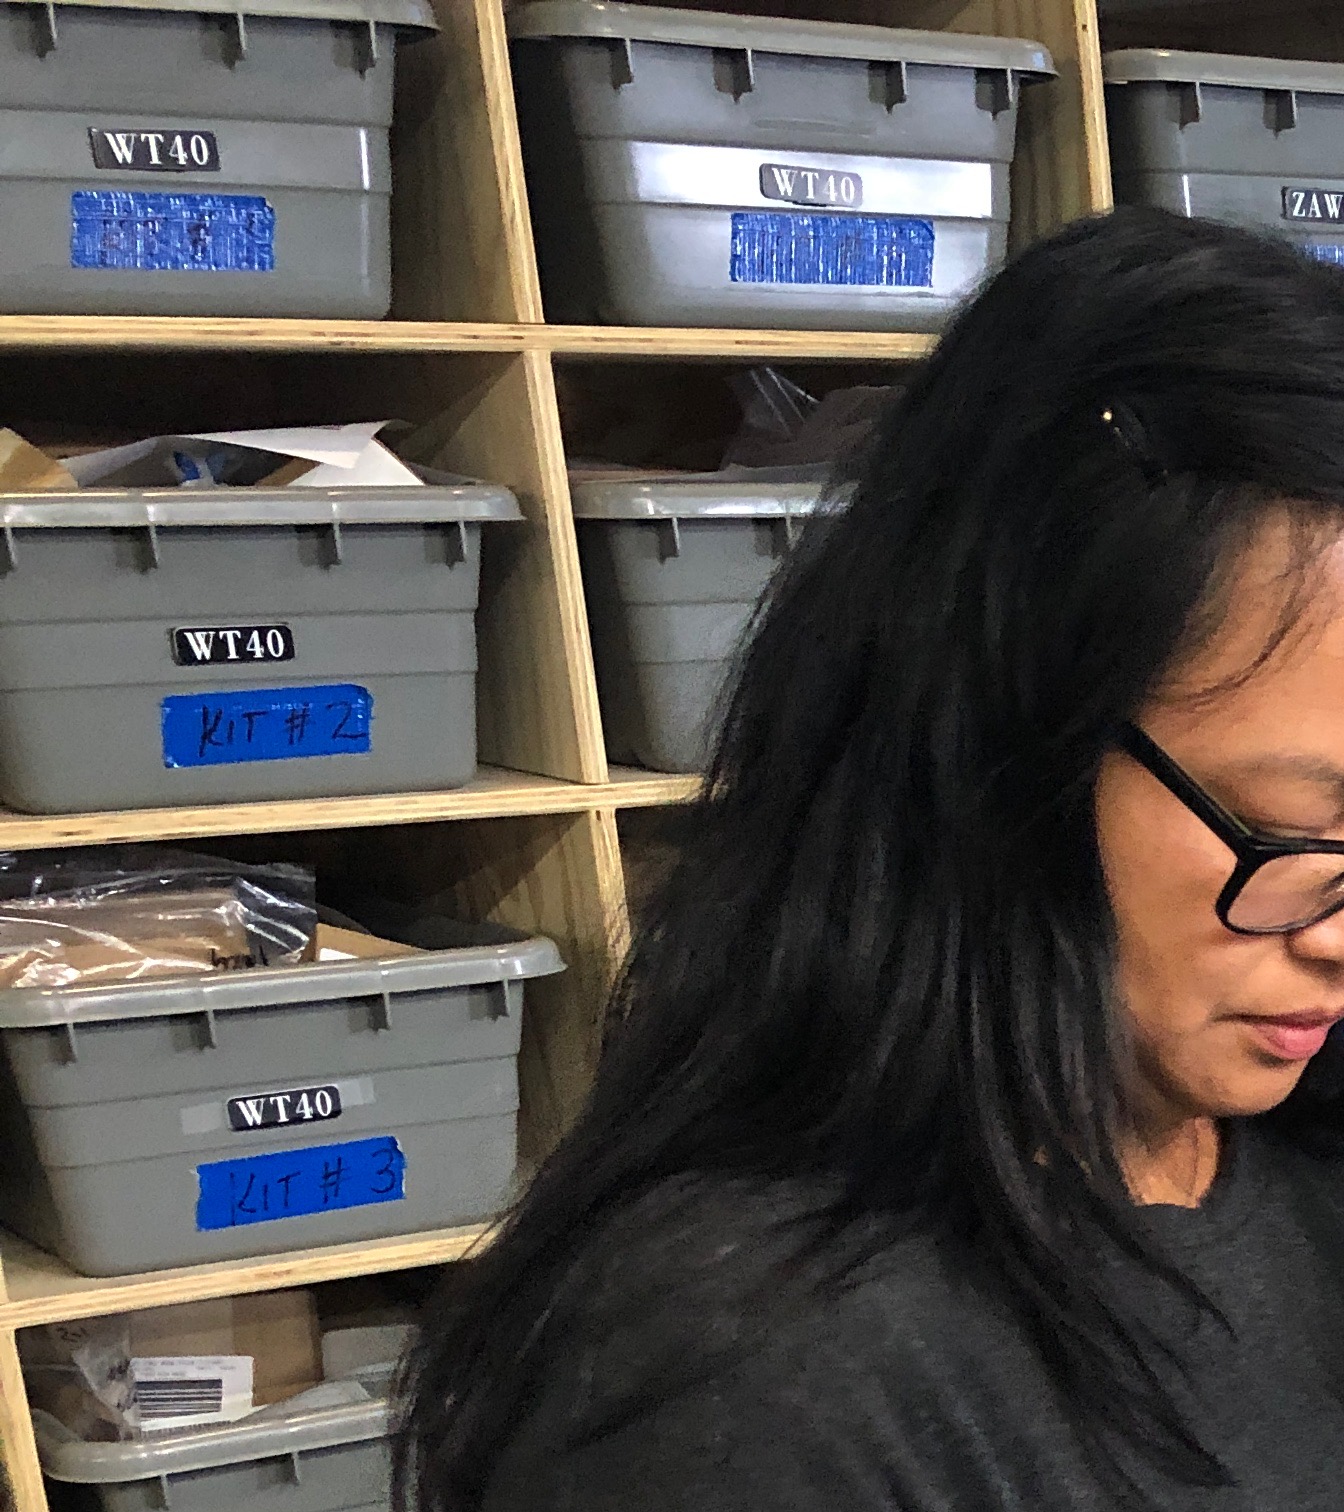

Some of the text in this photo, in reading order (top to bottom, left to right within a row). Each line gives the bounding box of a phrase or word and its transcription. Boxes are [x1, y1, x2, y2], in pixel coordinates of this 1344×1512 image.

[104, 132, 208, 165] WT40
[771, 168, 855, 202] WT40
[184, 629, 285, 661] WT40
[198, 704, 269, 757] KIT
[236, 1090, 333, 1127] WT40
[230, 1171, 301, 1226] KIT
